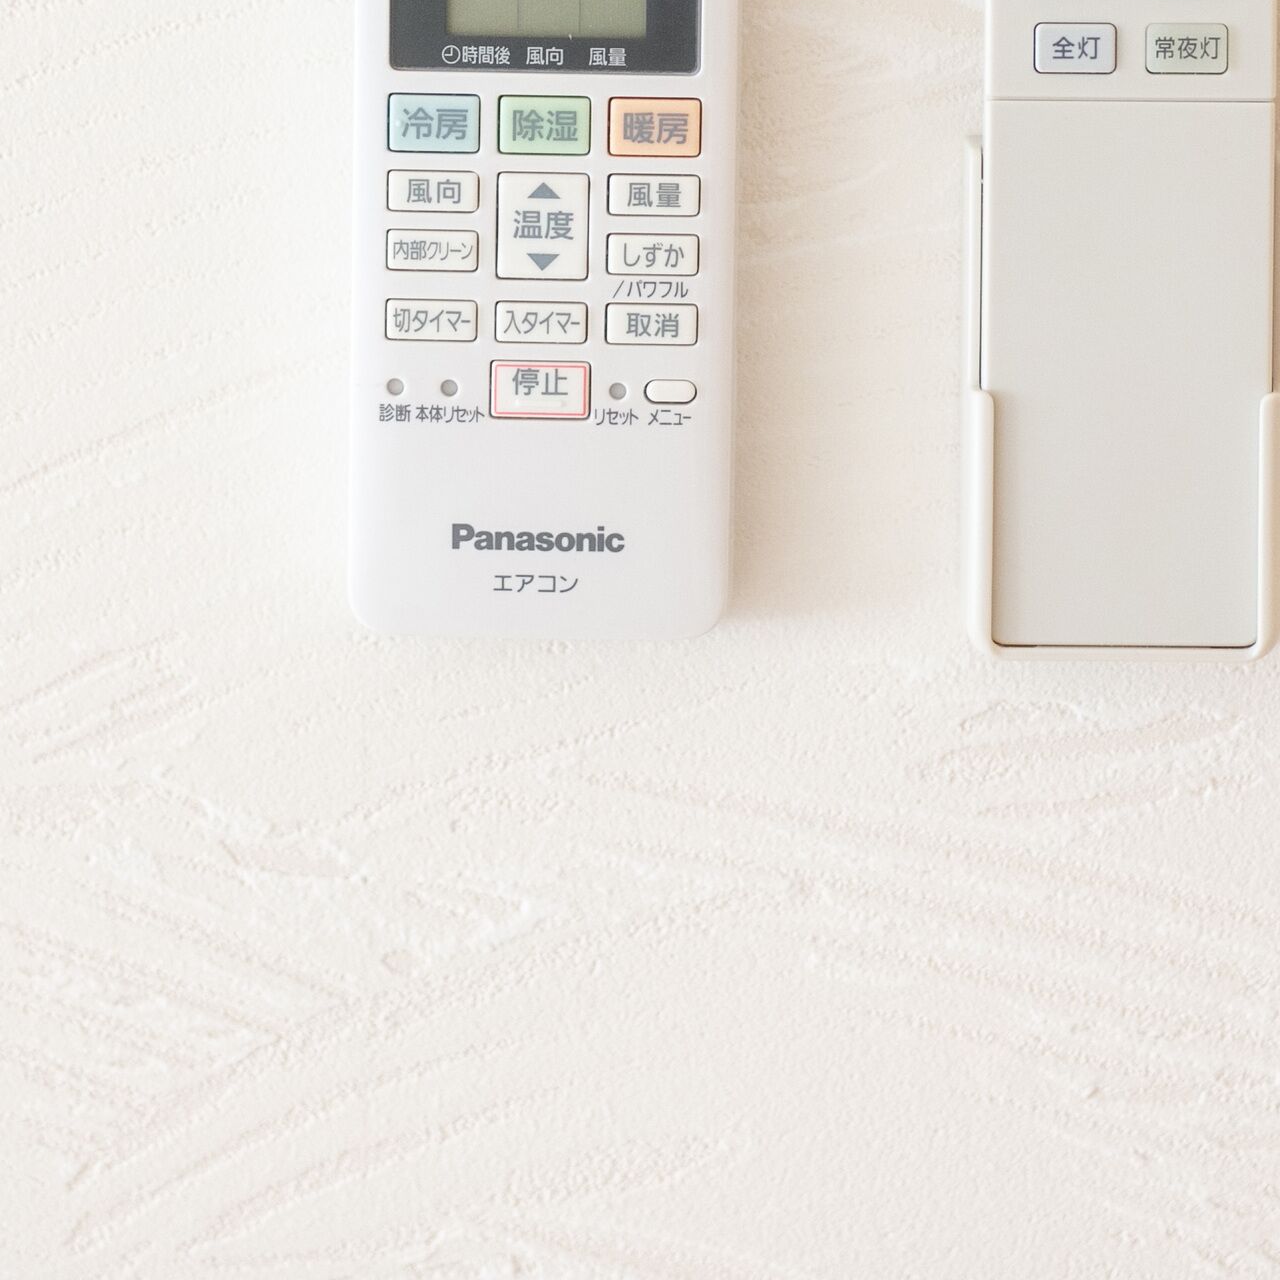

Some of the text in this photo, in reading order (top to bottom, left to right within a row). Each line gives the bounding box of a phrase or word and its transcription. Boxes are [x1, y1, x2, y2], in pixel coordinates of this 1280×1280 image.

[461, 45, 511, 65] 時間後
[525, 46, 564, 66] 風向
[588, 47, 628, 67] 風量
[1051, 36, 1101, 61] 全灯
[1154, 36, 1222, 61] 常夜灯
[400, 106, 469, 141] 冷房
[511, 109, 579, 143] 除湿
[622, 111, 690, 146] 暖房
[406, 179, 462, 205] 風向
[626, 182, 683, 209] 風量
[512, 209, 575, 241] 温度
[392, 239, 474, 262] 内部クリーン
[622, 242, 685, 269] しずか
[392, 307, 472, 334] 切タイマー
[502, 310, 581, 336] 入タイマー
[625, 312, 680, 339] 取消
[511, 368, 569, 397] 停止
[378, 403, 412, 423] 診断
[415, 404, 485, 424] 本体リセット
[594, 408, 640, 426] リセット
[647, 410, 693, 427] メニュー
[451, 522, 626, 554] Panasonic
[492, 573, 580, 595] エアコン
